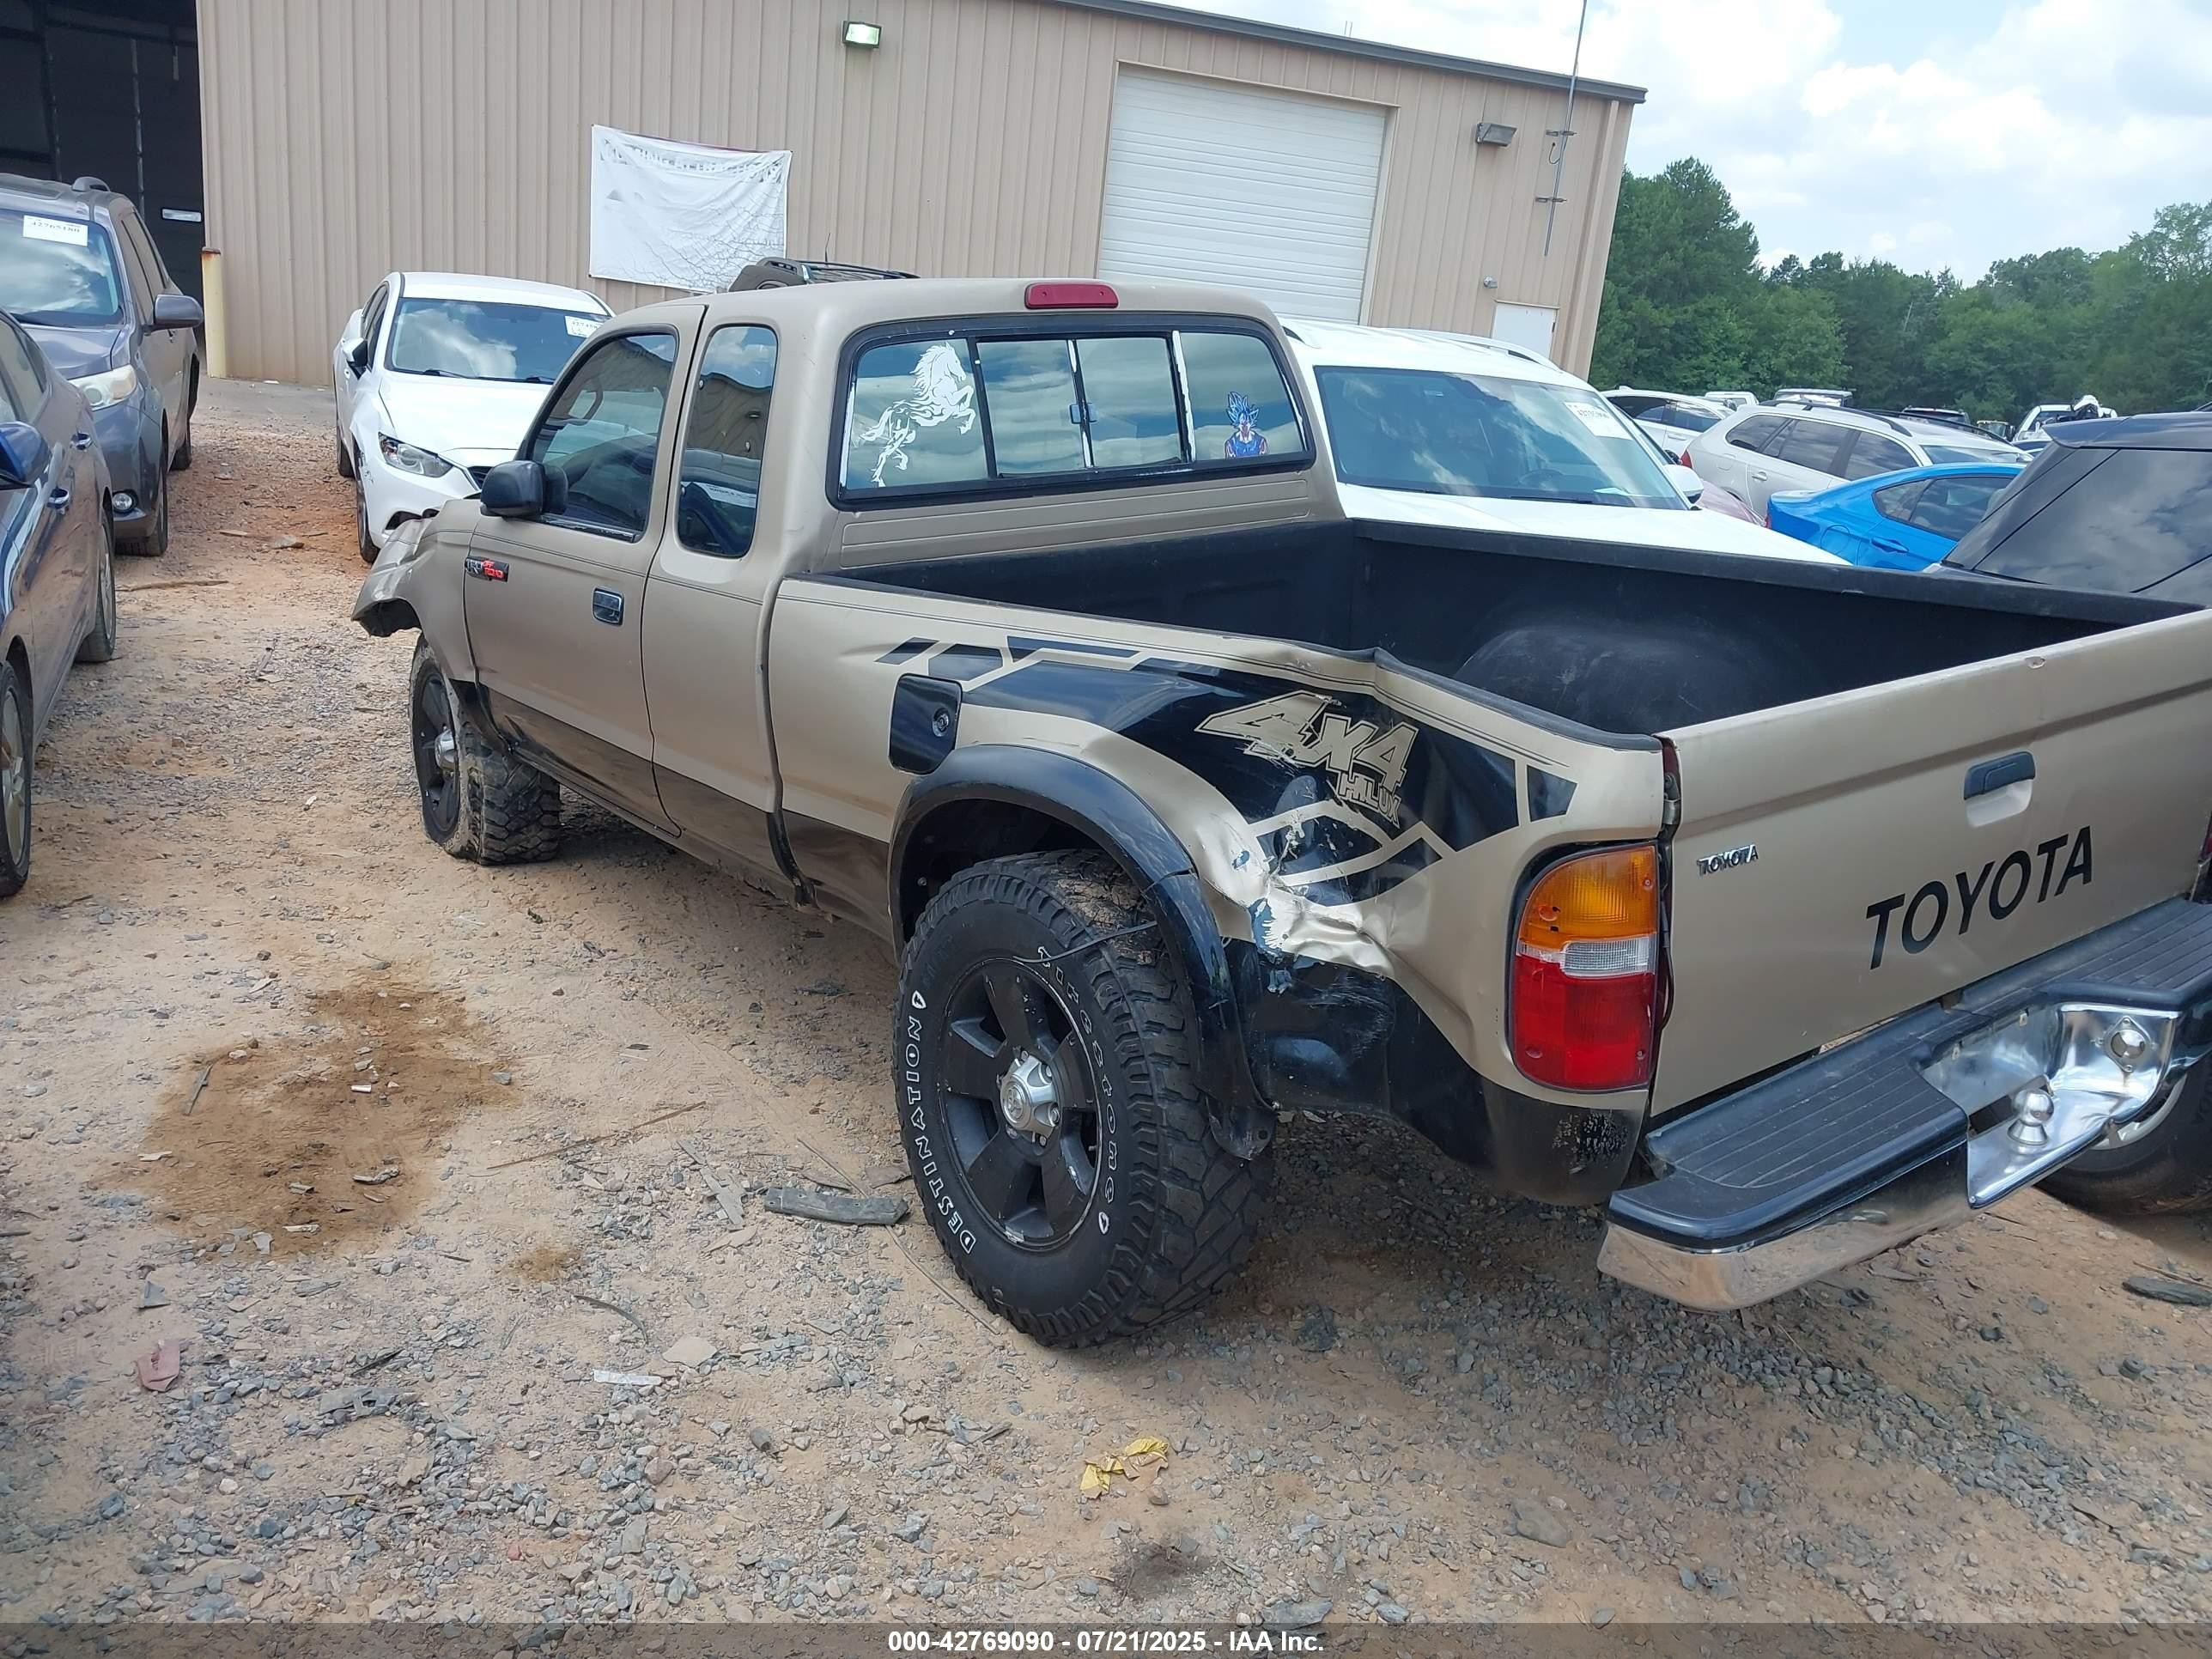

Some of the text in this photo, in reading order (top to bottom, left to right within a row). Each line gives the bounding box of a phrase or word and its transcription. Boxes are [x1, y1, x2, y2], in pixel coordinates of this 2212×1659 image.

[1696, 844, 1759, 877] TOYOTA
[1865, 824, 2093, 971] TOYOTA
[905, 1015, 977, 1255] DESTINATION
